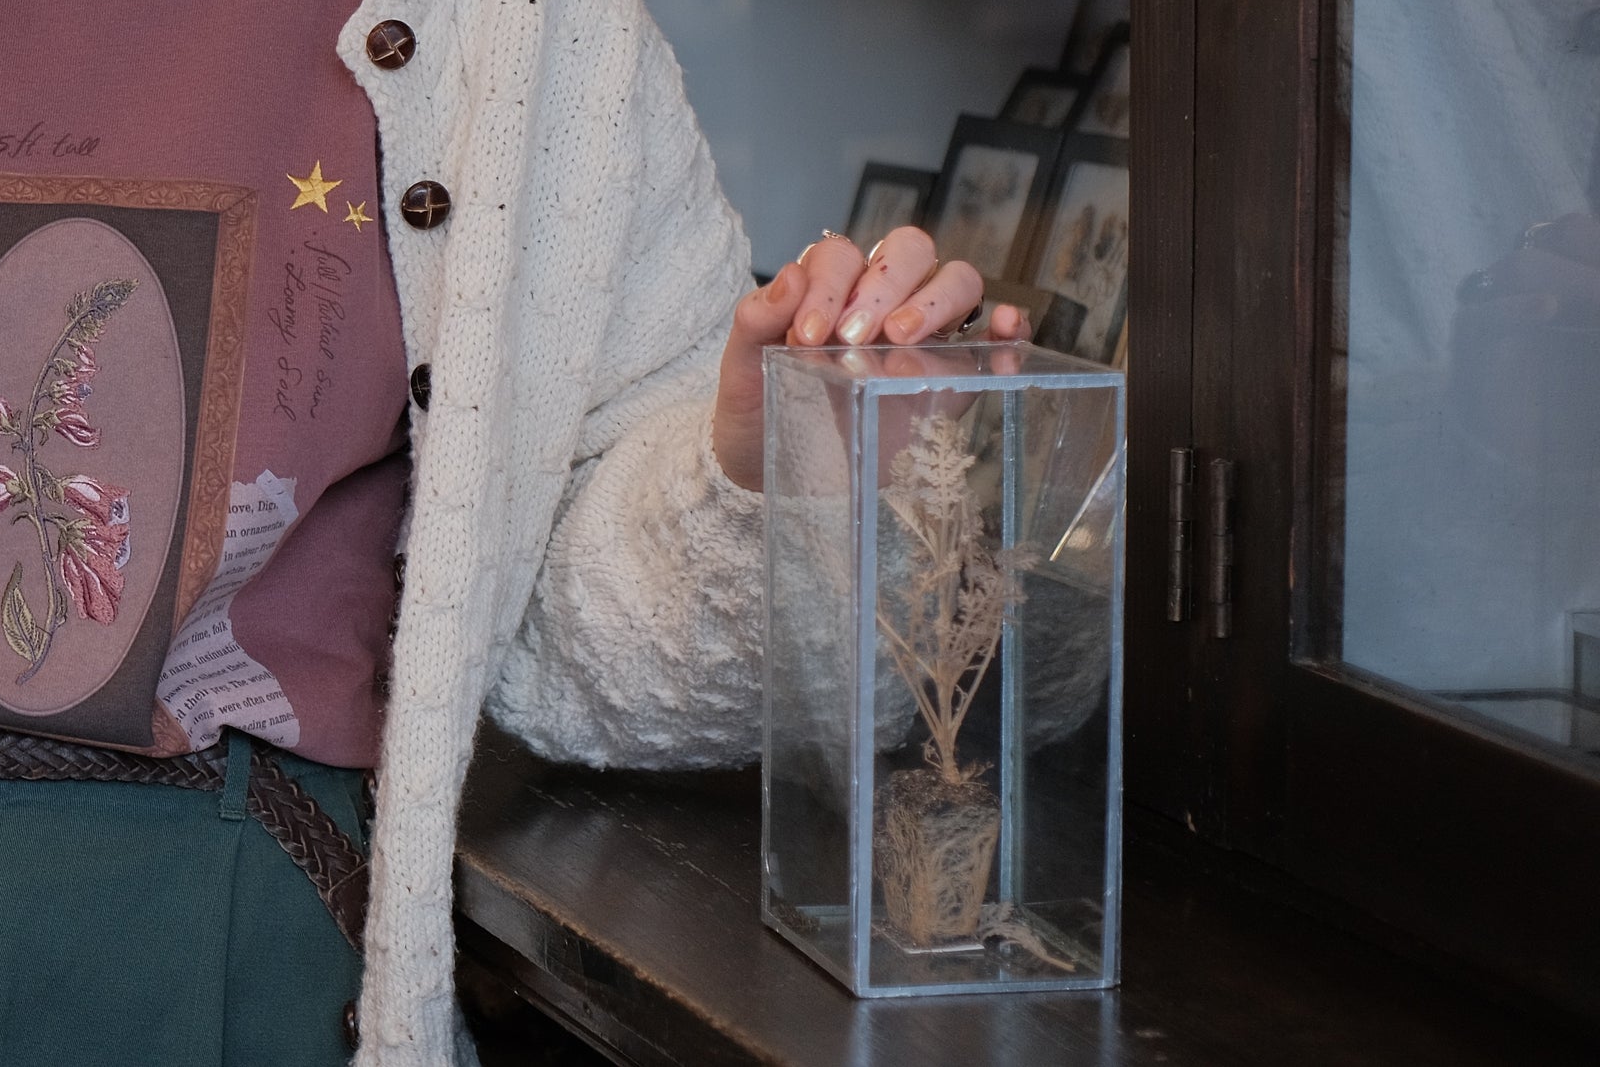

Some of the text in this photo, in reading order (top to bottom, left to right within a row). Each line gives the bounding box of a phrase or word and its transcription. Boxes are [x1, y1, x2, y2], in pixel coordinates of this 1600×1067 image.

[52, 133, 100, 157] tall
[267, 262, 306, 423] Loamy Soil
[309, 369, 332, 420] Sun
[223, 551, 234, 562] in
[191, 631, 211, 643] time,
[212, 620, 229, 635] folk
[169, 662, 197, 677] name,
[184, 688, 209, 710] their
[218, 701, 243, 715] were
[243, 695, 266, 709] often
